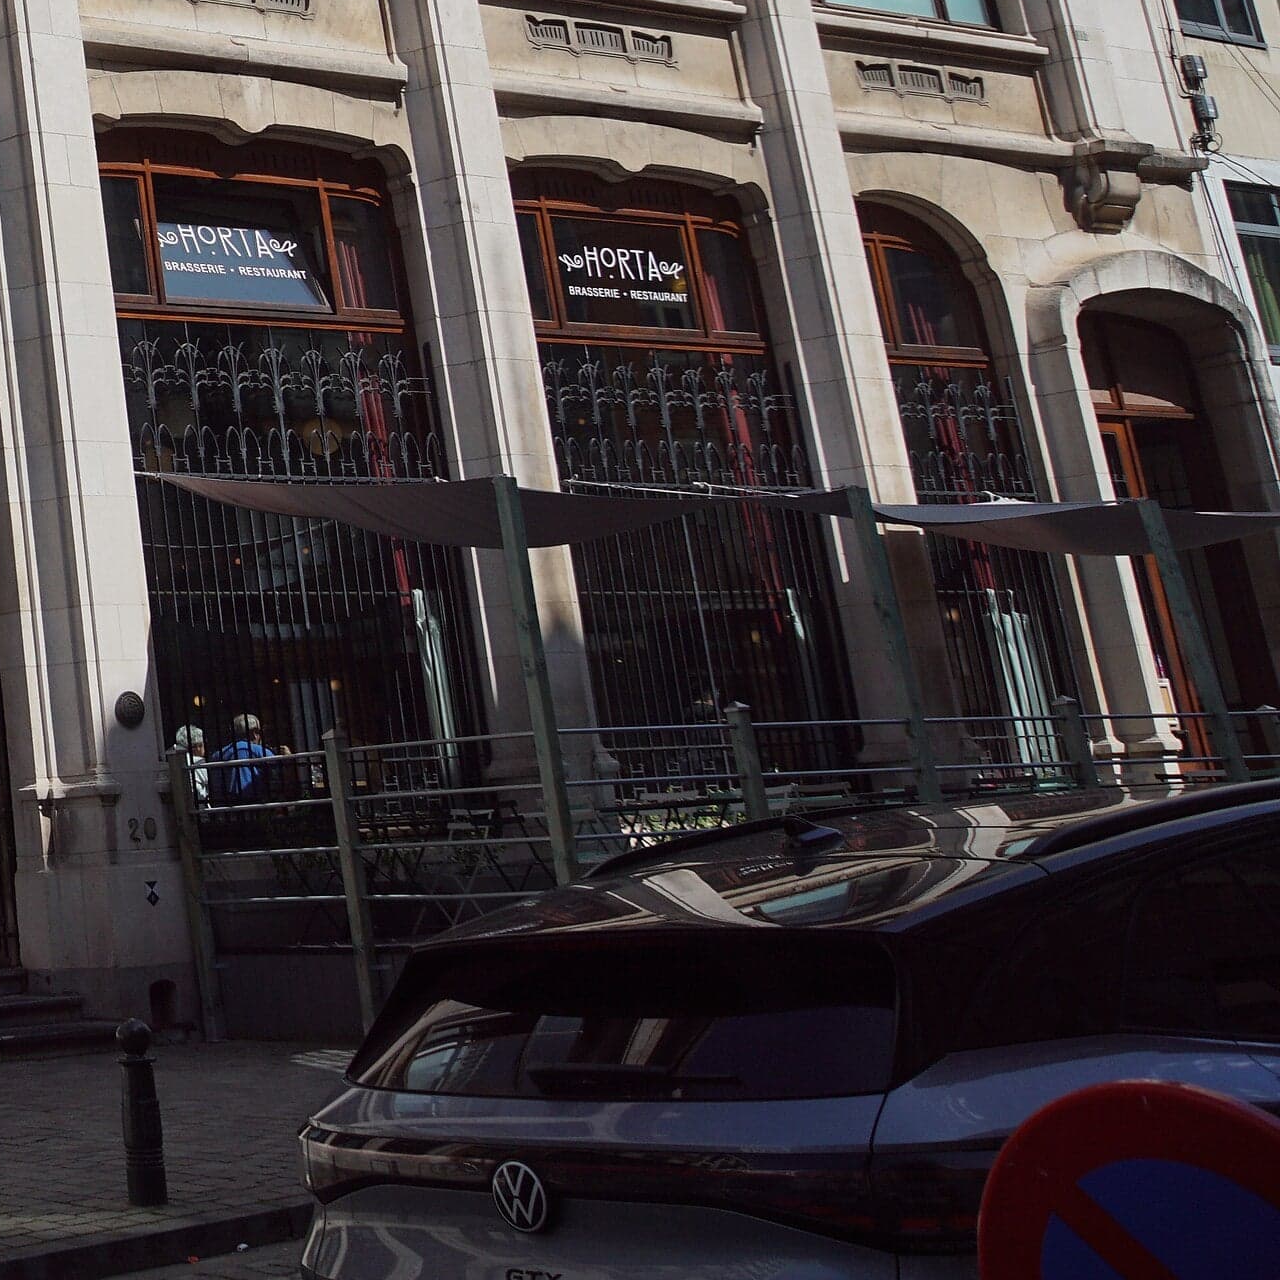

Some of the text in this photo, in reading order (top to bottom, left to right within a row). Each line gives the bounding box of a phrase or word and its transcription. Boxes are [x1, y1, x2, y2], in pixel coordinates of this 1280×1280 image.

[177, 223, 274, 259] HORTA
[164, 261, 308, 280] BRASSERIE RESTAURANT
[583, 245, 663, 281] HORTA
[568, 285, 688, 302] BRASSERIE RESTAURANT
[127, 817, 157, 841] 20
